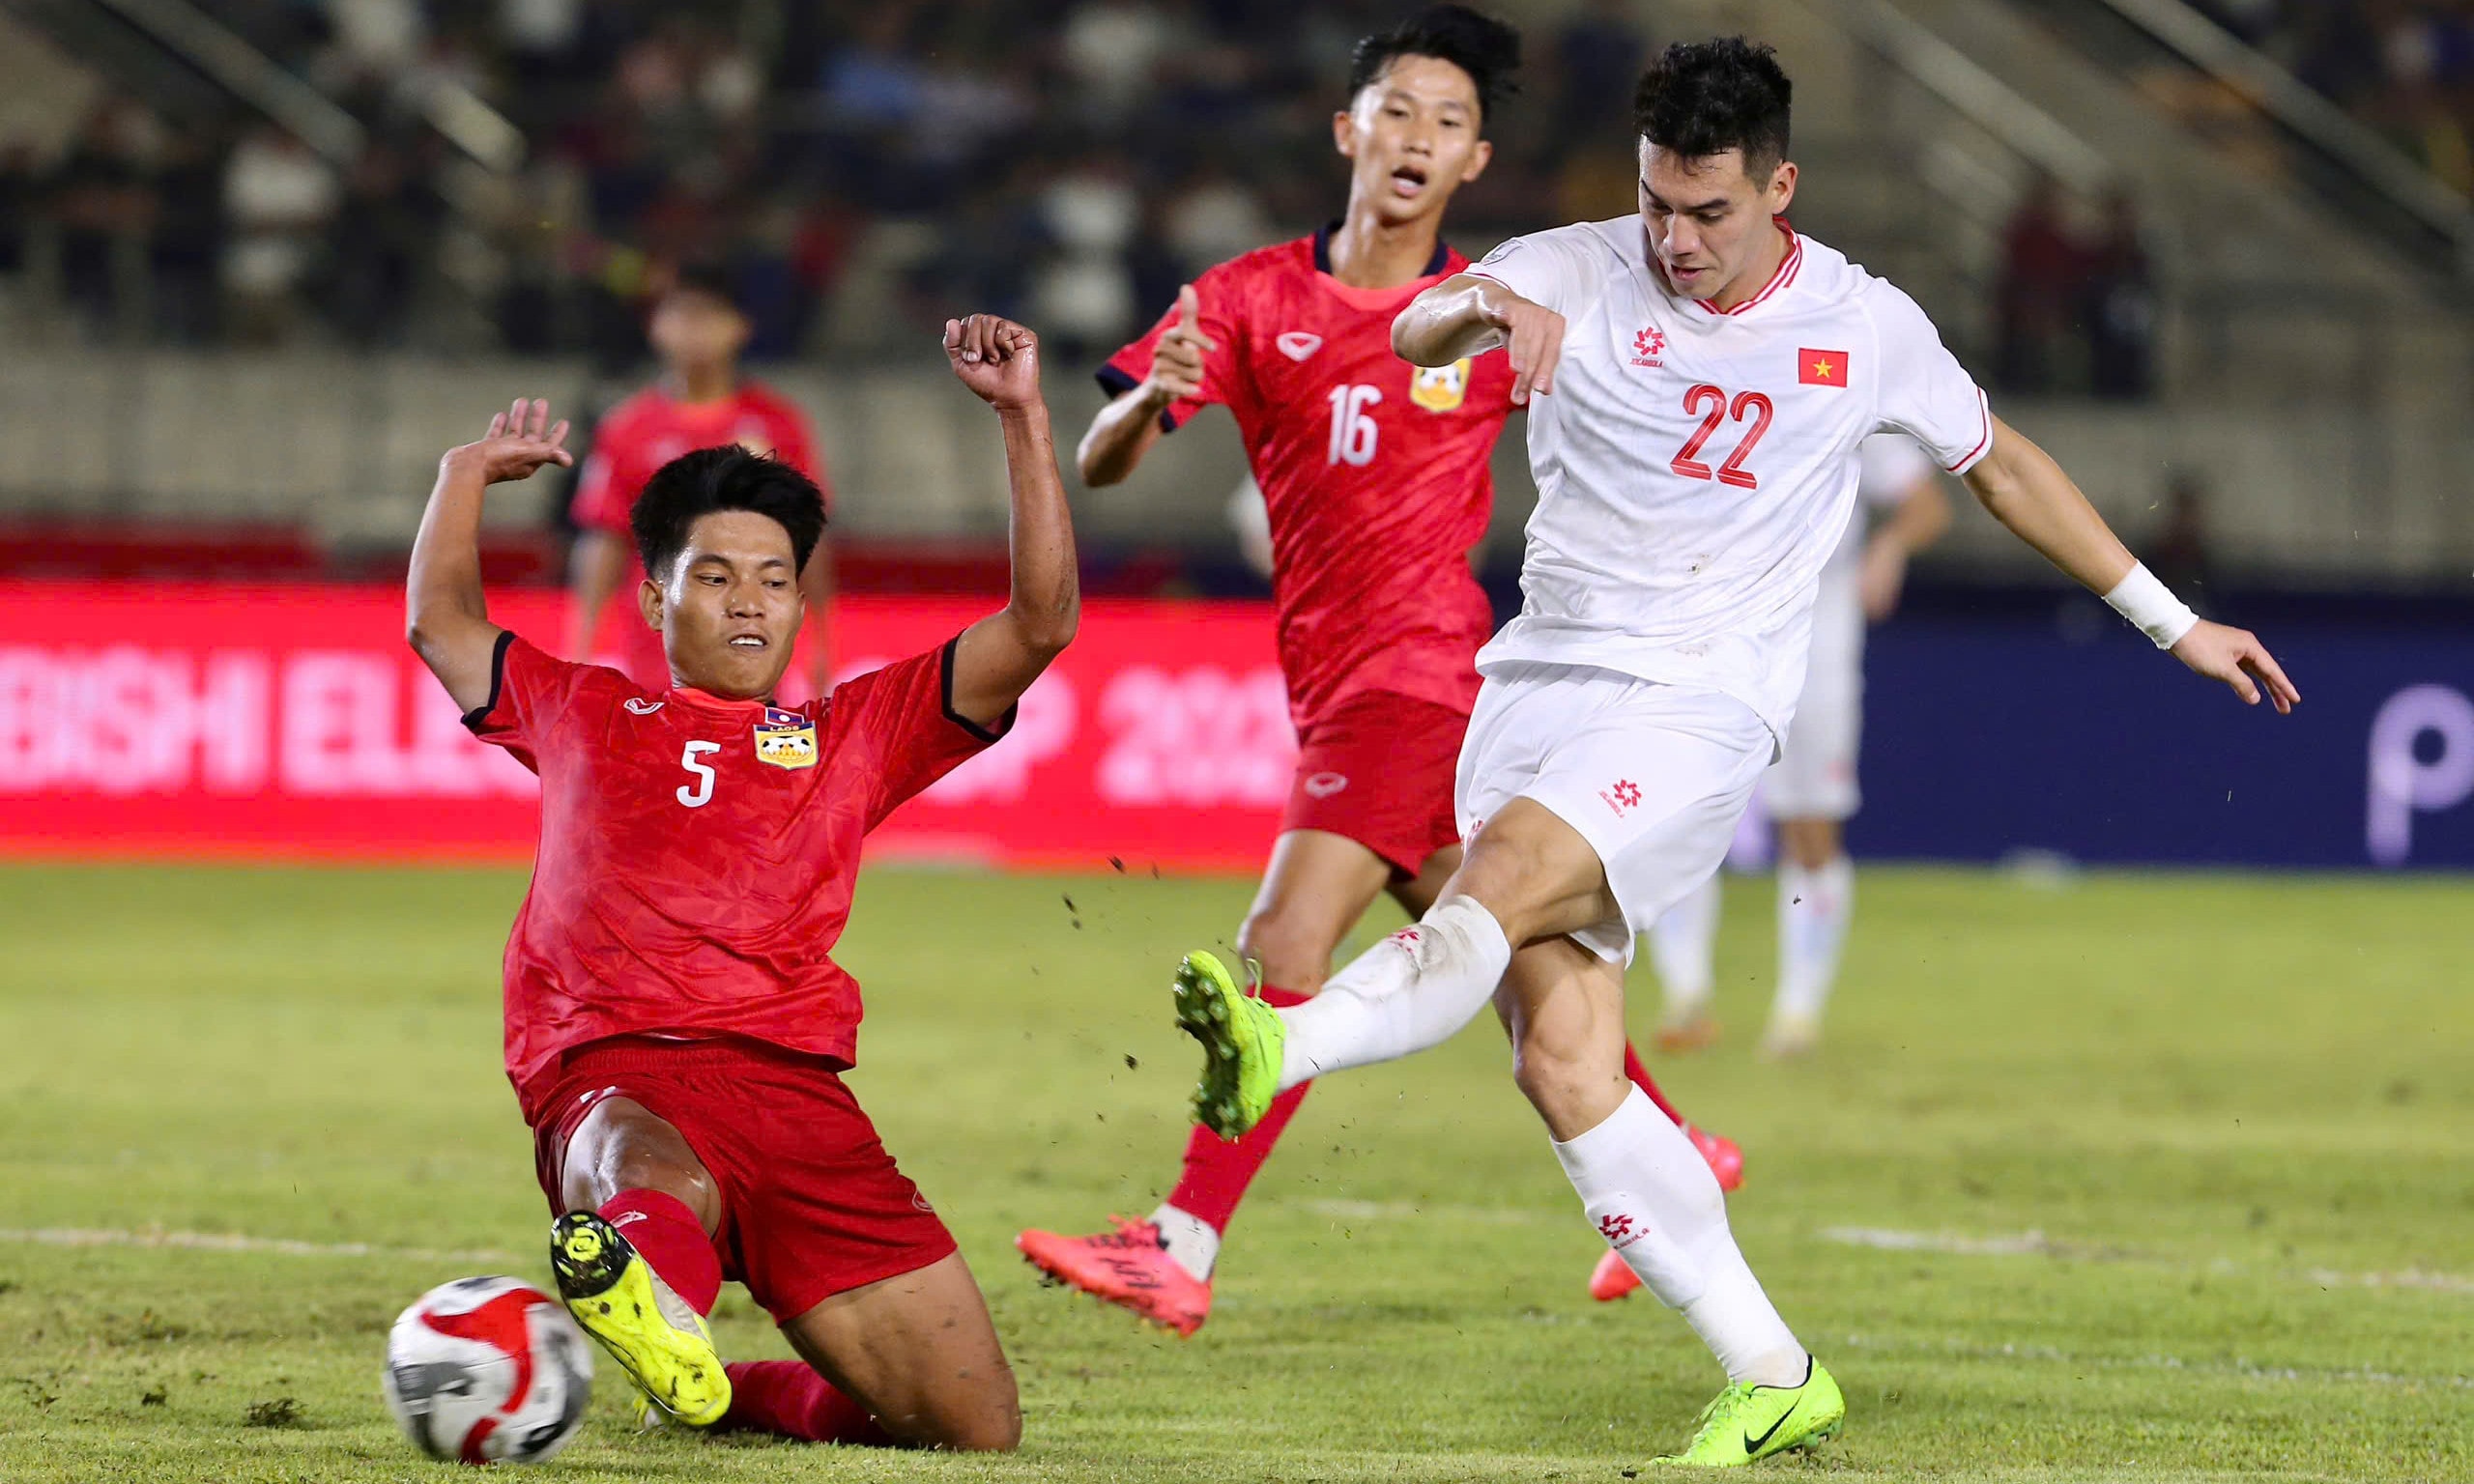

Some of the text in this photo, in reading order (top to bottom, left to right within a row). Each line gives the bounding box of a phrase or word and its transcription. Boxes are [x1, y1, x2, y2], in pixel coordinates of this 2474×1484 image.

[1328, 384, 1382, 466] 16
[1670, 383, 1773, 490] 22
[676, 740, 721, 808] 5
